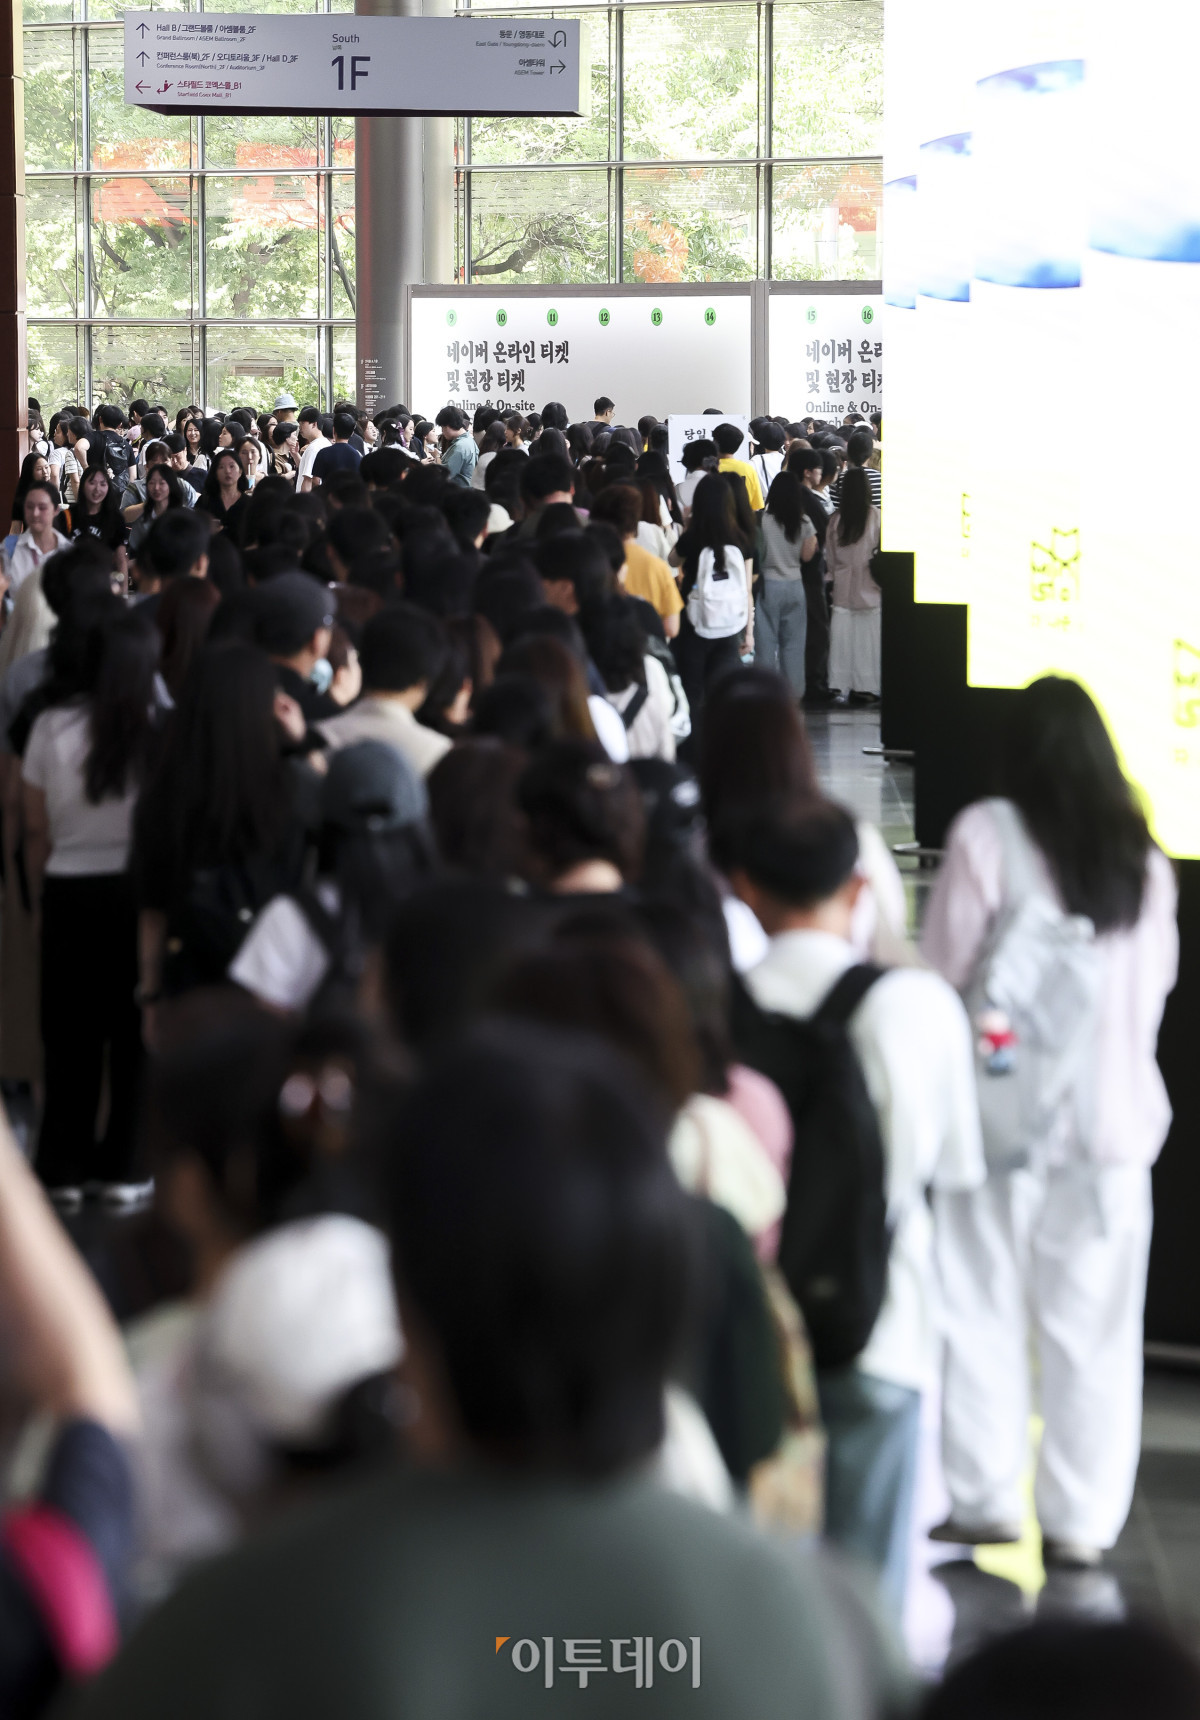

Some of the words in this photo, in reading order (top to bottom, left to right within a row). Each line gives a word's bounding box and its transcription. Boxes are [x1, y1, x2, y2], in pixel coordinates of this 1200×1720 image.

[332, 34, 360, 43] South
[332, 56, 370, 90] 1F
[449, 314, 454, 323] 9
[498, 313, 506, 322] 10
[550, 313, 556, 322] 11
[601, 313, 608, 321] 12
[653, 313, 661, 322] 13
[706, 312, 714, 321] 14
[807, 311, 815, 320] 15
[863, 310, 872, 320] 16
[447, 341, 488, 364] 네이버
[493, 341, 536, 363] 온라인
[540, 341, 569, 364] 티켓
[806, 339, 852, 363] 네이버
[447, 369, 460, 392] 및
[465, 369, 493, 392] 현장
[497, 369, 525, 392] 티켓
[806, 369, 820, 393] 및
[826, 369, 857, 393] 현장
[497, 400, 535, 410] On-site
[806, 401, 844, 413] Online
[848, 401, 858, 413] &
[861, 401, 882, 413] On-
